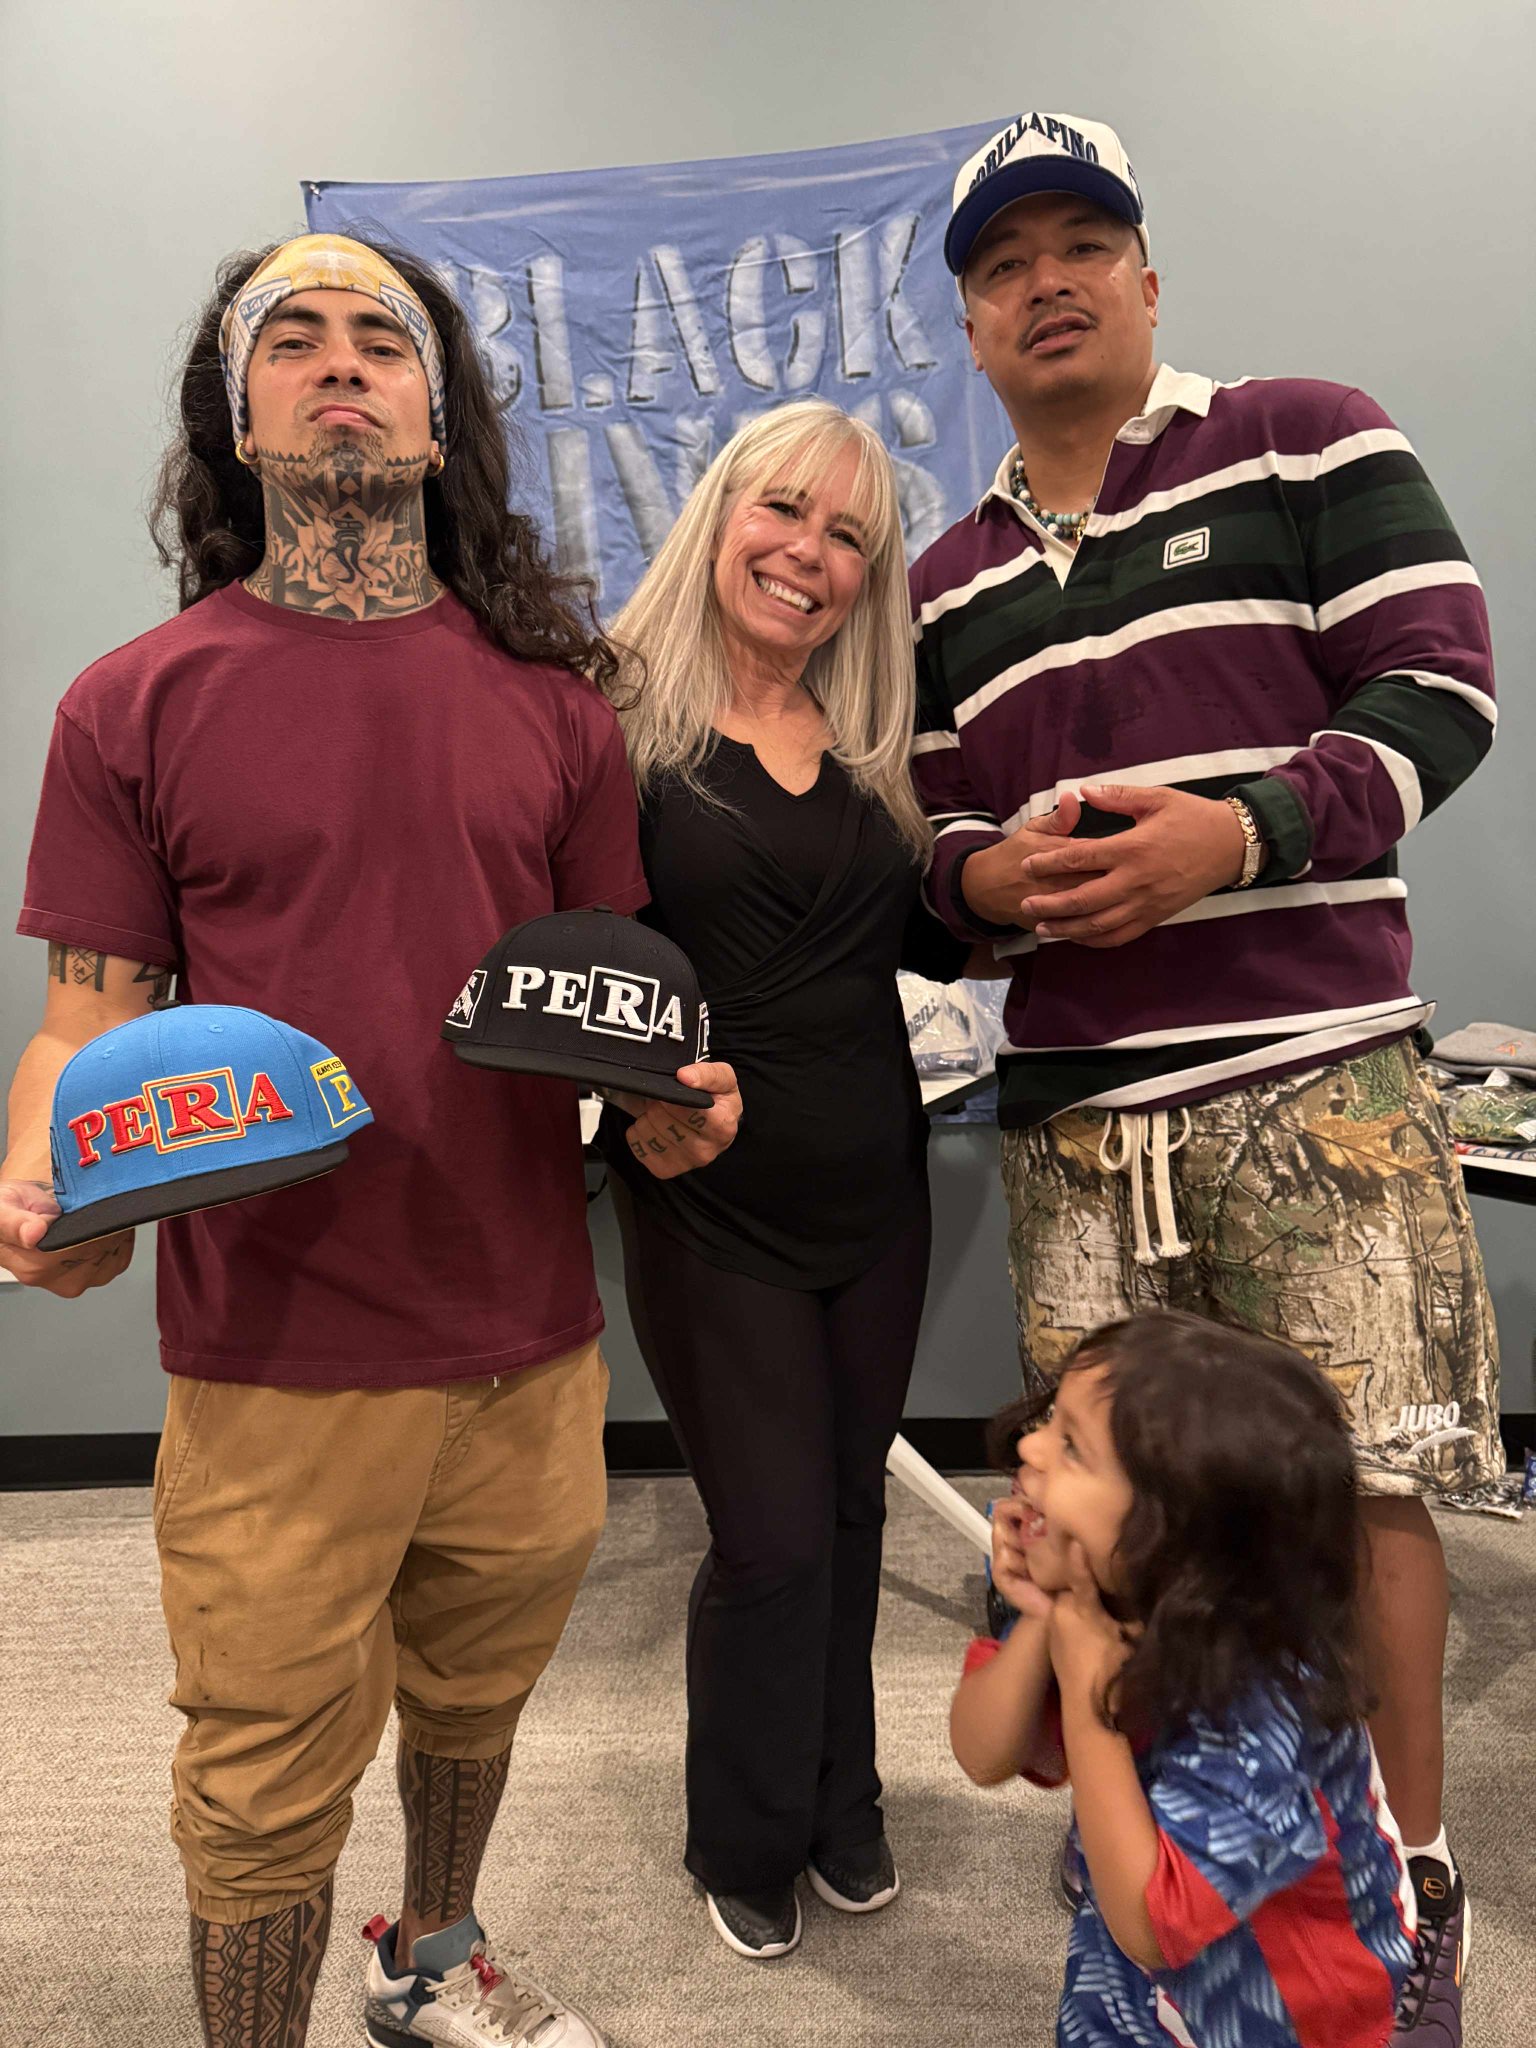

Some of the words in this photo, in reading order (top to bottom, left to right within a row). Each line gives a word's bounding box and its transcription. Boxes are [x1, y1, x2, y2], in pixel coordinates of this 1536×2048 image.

[437, 213, 938, 411] BLACK
[502, 965, 685, 1042] PERA
[68, 1072, 294, 1168] PERA
[330, 1074, 356, 1112] P
[1389, 1401, 1461, 1433] JUBO
